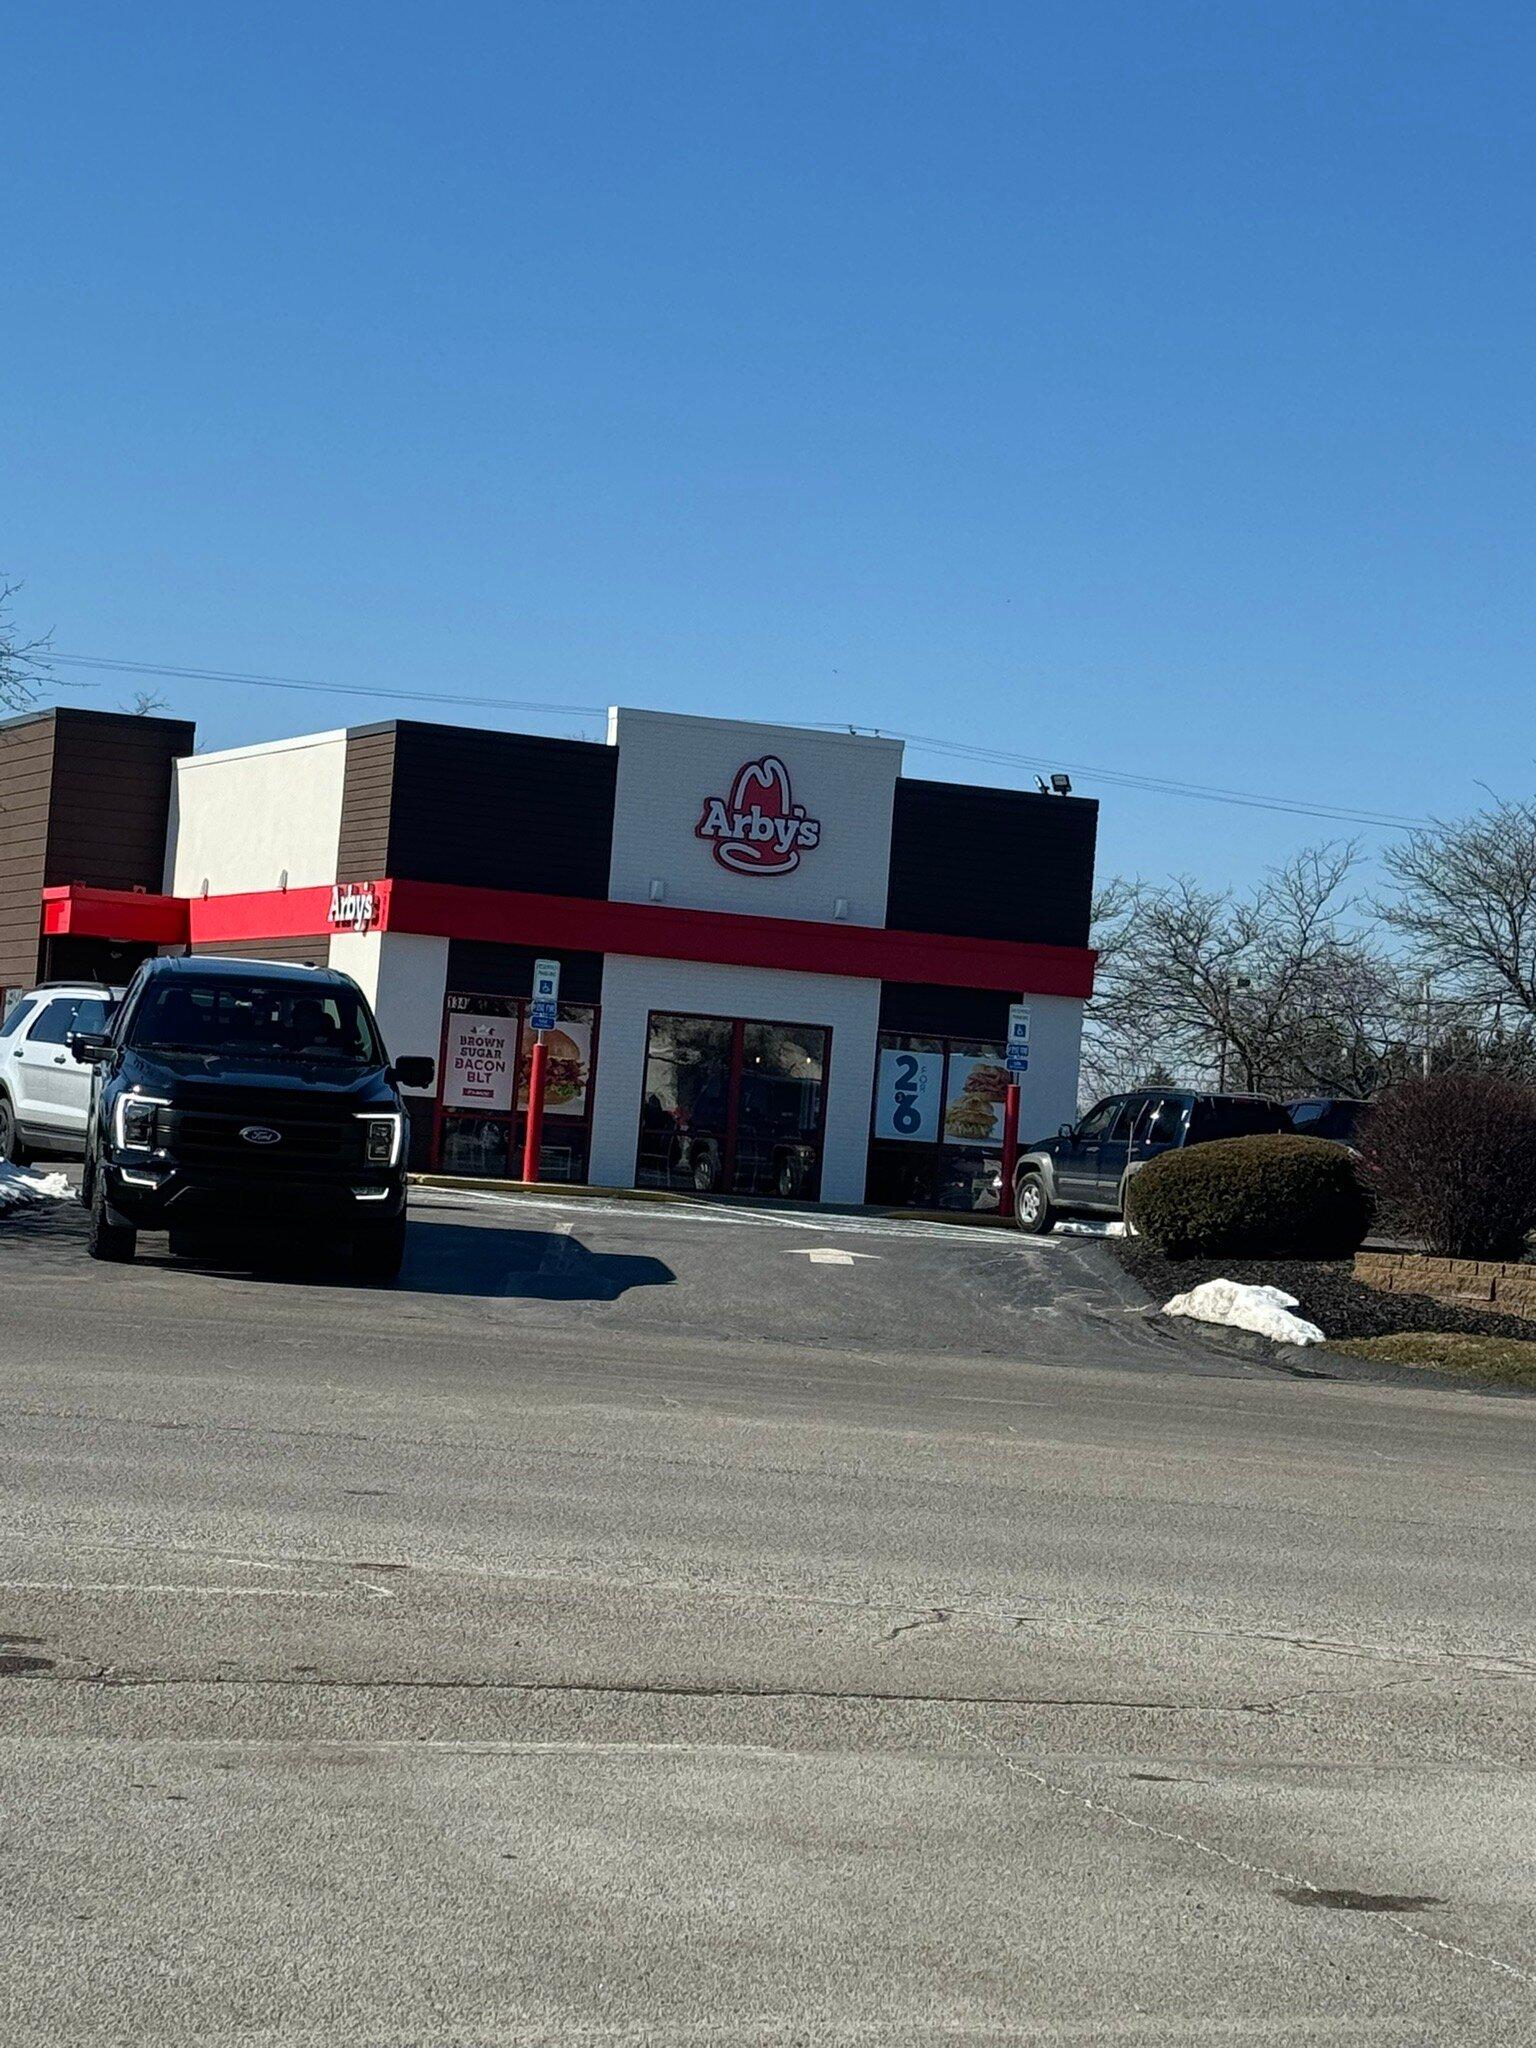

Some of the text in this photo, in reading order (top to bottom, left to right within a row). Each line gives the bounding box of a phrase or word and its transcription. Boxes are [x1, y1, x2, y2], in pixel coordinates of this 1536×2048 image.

[700, 800, 820, 853] Arby's
[326, 881, 373, 931] Arby's
[459, 1035, 505, 1048] BROWN
[459, 1046, 502, 1059] SUGAR
[454, 1057, 506, 1073] BACON
[894, 1055, 919, 1091] 2
[466, 1071, 492, 1084] BLT
